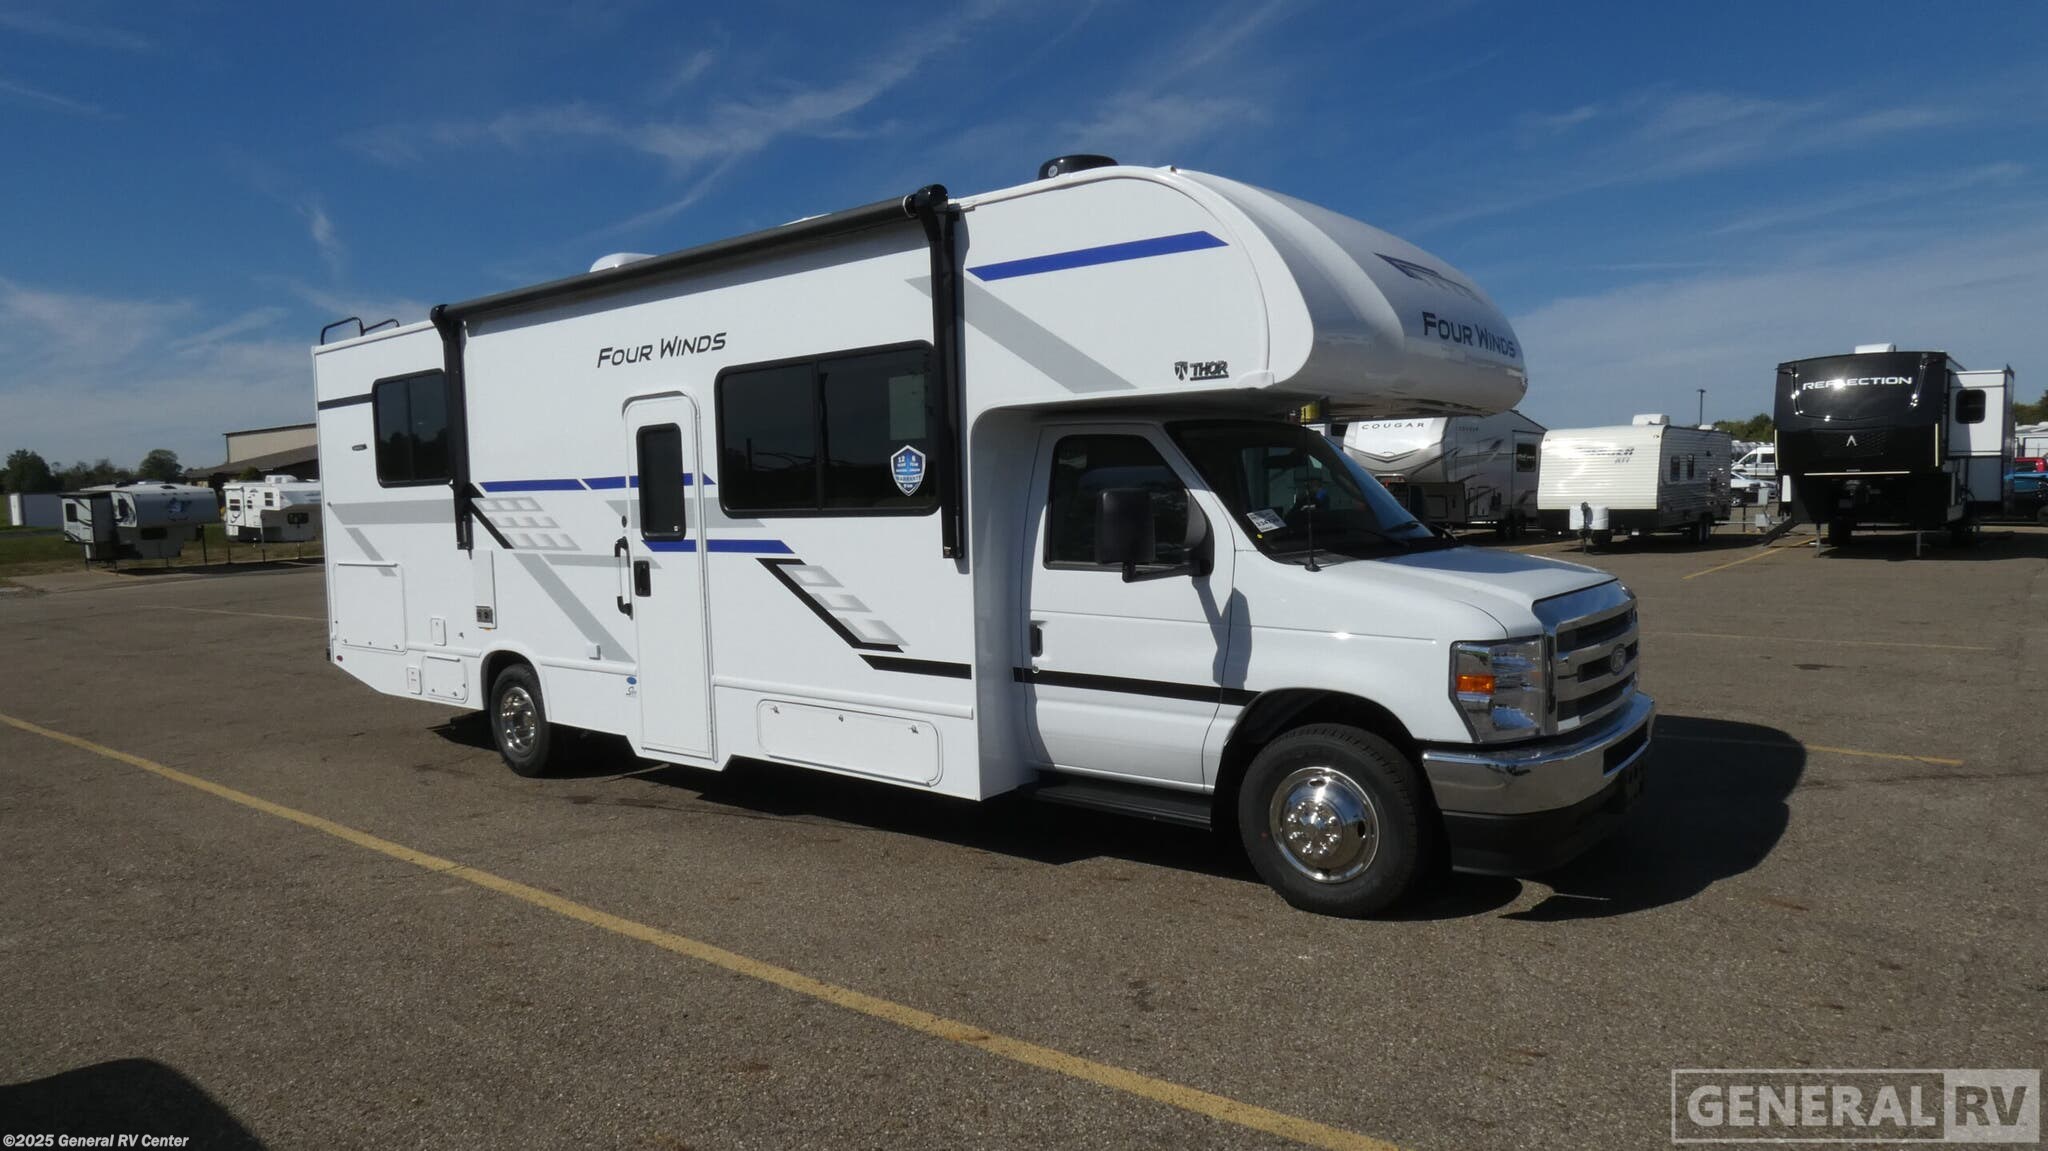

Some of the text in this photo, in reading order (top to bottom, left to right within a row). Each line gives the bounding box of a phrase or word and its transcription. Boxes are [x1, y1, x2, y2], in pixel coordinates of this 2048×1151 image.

[1422, 311, 1517, 359] FOUR WINDS
[597, 332, 727, 368] FOUR WINDS
[1189, 360, 1229, 376] THOR
[1802, 377, 1913, 391] REFECTION
[1361, 422, 1425, 430] COUGAR
